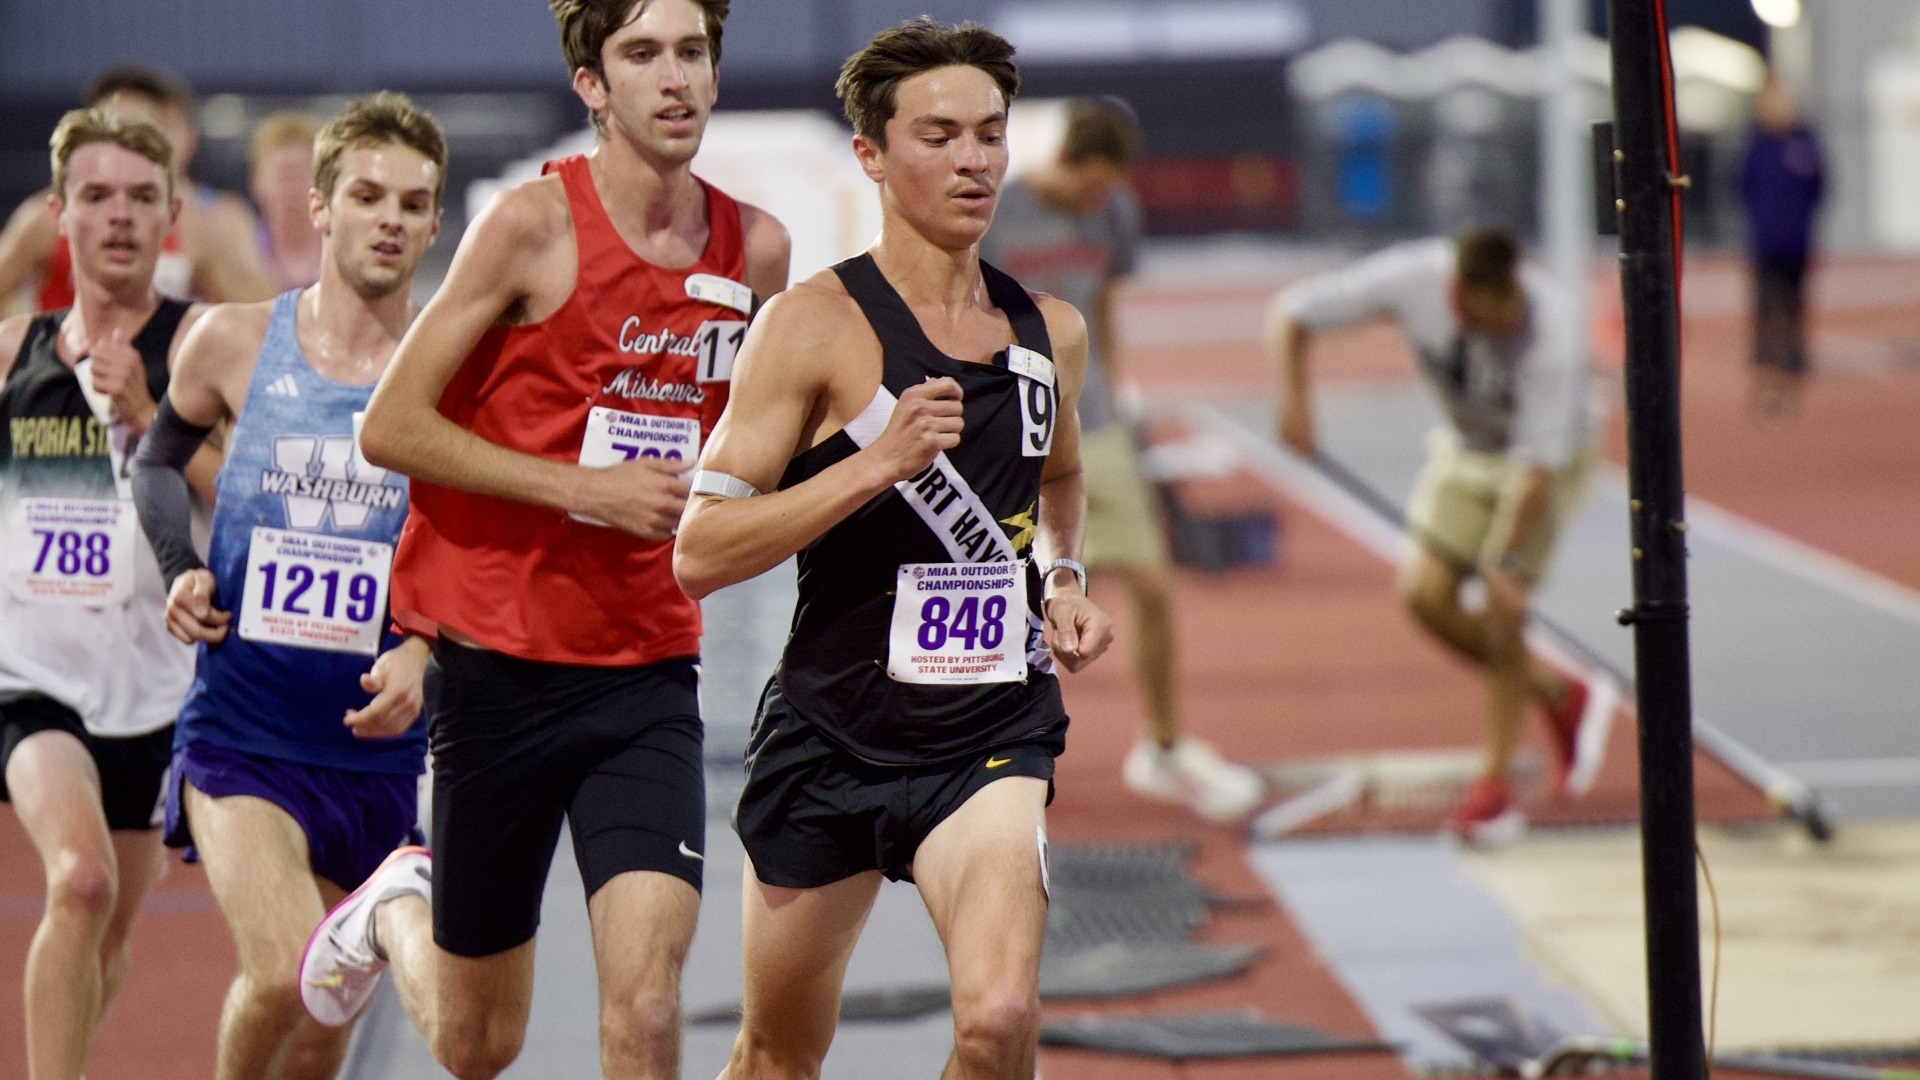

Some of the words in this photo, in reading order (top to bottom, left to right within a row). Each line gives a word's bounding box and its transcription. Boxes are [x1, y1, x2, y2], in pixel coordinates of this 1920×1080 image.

[618, 315, 703, 357] Central
[619, 415, 647, 427] MIAA
[650, 418, 685, 430] OUTDOOR
[1027, 379, 1052, 451] 9
[608, 425, 690, 444] CHAMPIONSHIPS
[260, 469, 403, 509] WASHBURN
[32, 529, 110, 576] 788
[917, 578, 1015, 591] CHAMPIONSHIPS
[927, 567, 957, 577] MIAA
[961, 565, 1009, 576] OUTDOOR
[259, 561, 377, 623] 1219
[917, 594, 1007, 650] 848
[911, 655, 946, 664] HOSTED
[947, 656, 960, 664] BY
[963, 653, 1005, 664] PITTSBURG
[918, 666, 946, 674] STATE
[949, 664, 997, 674] UNIVERSITY
